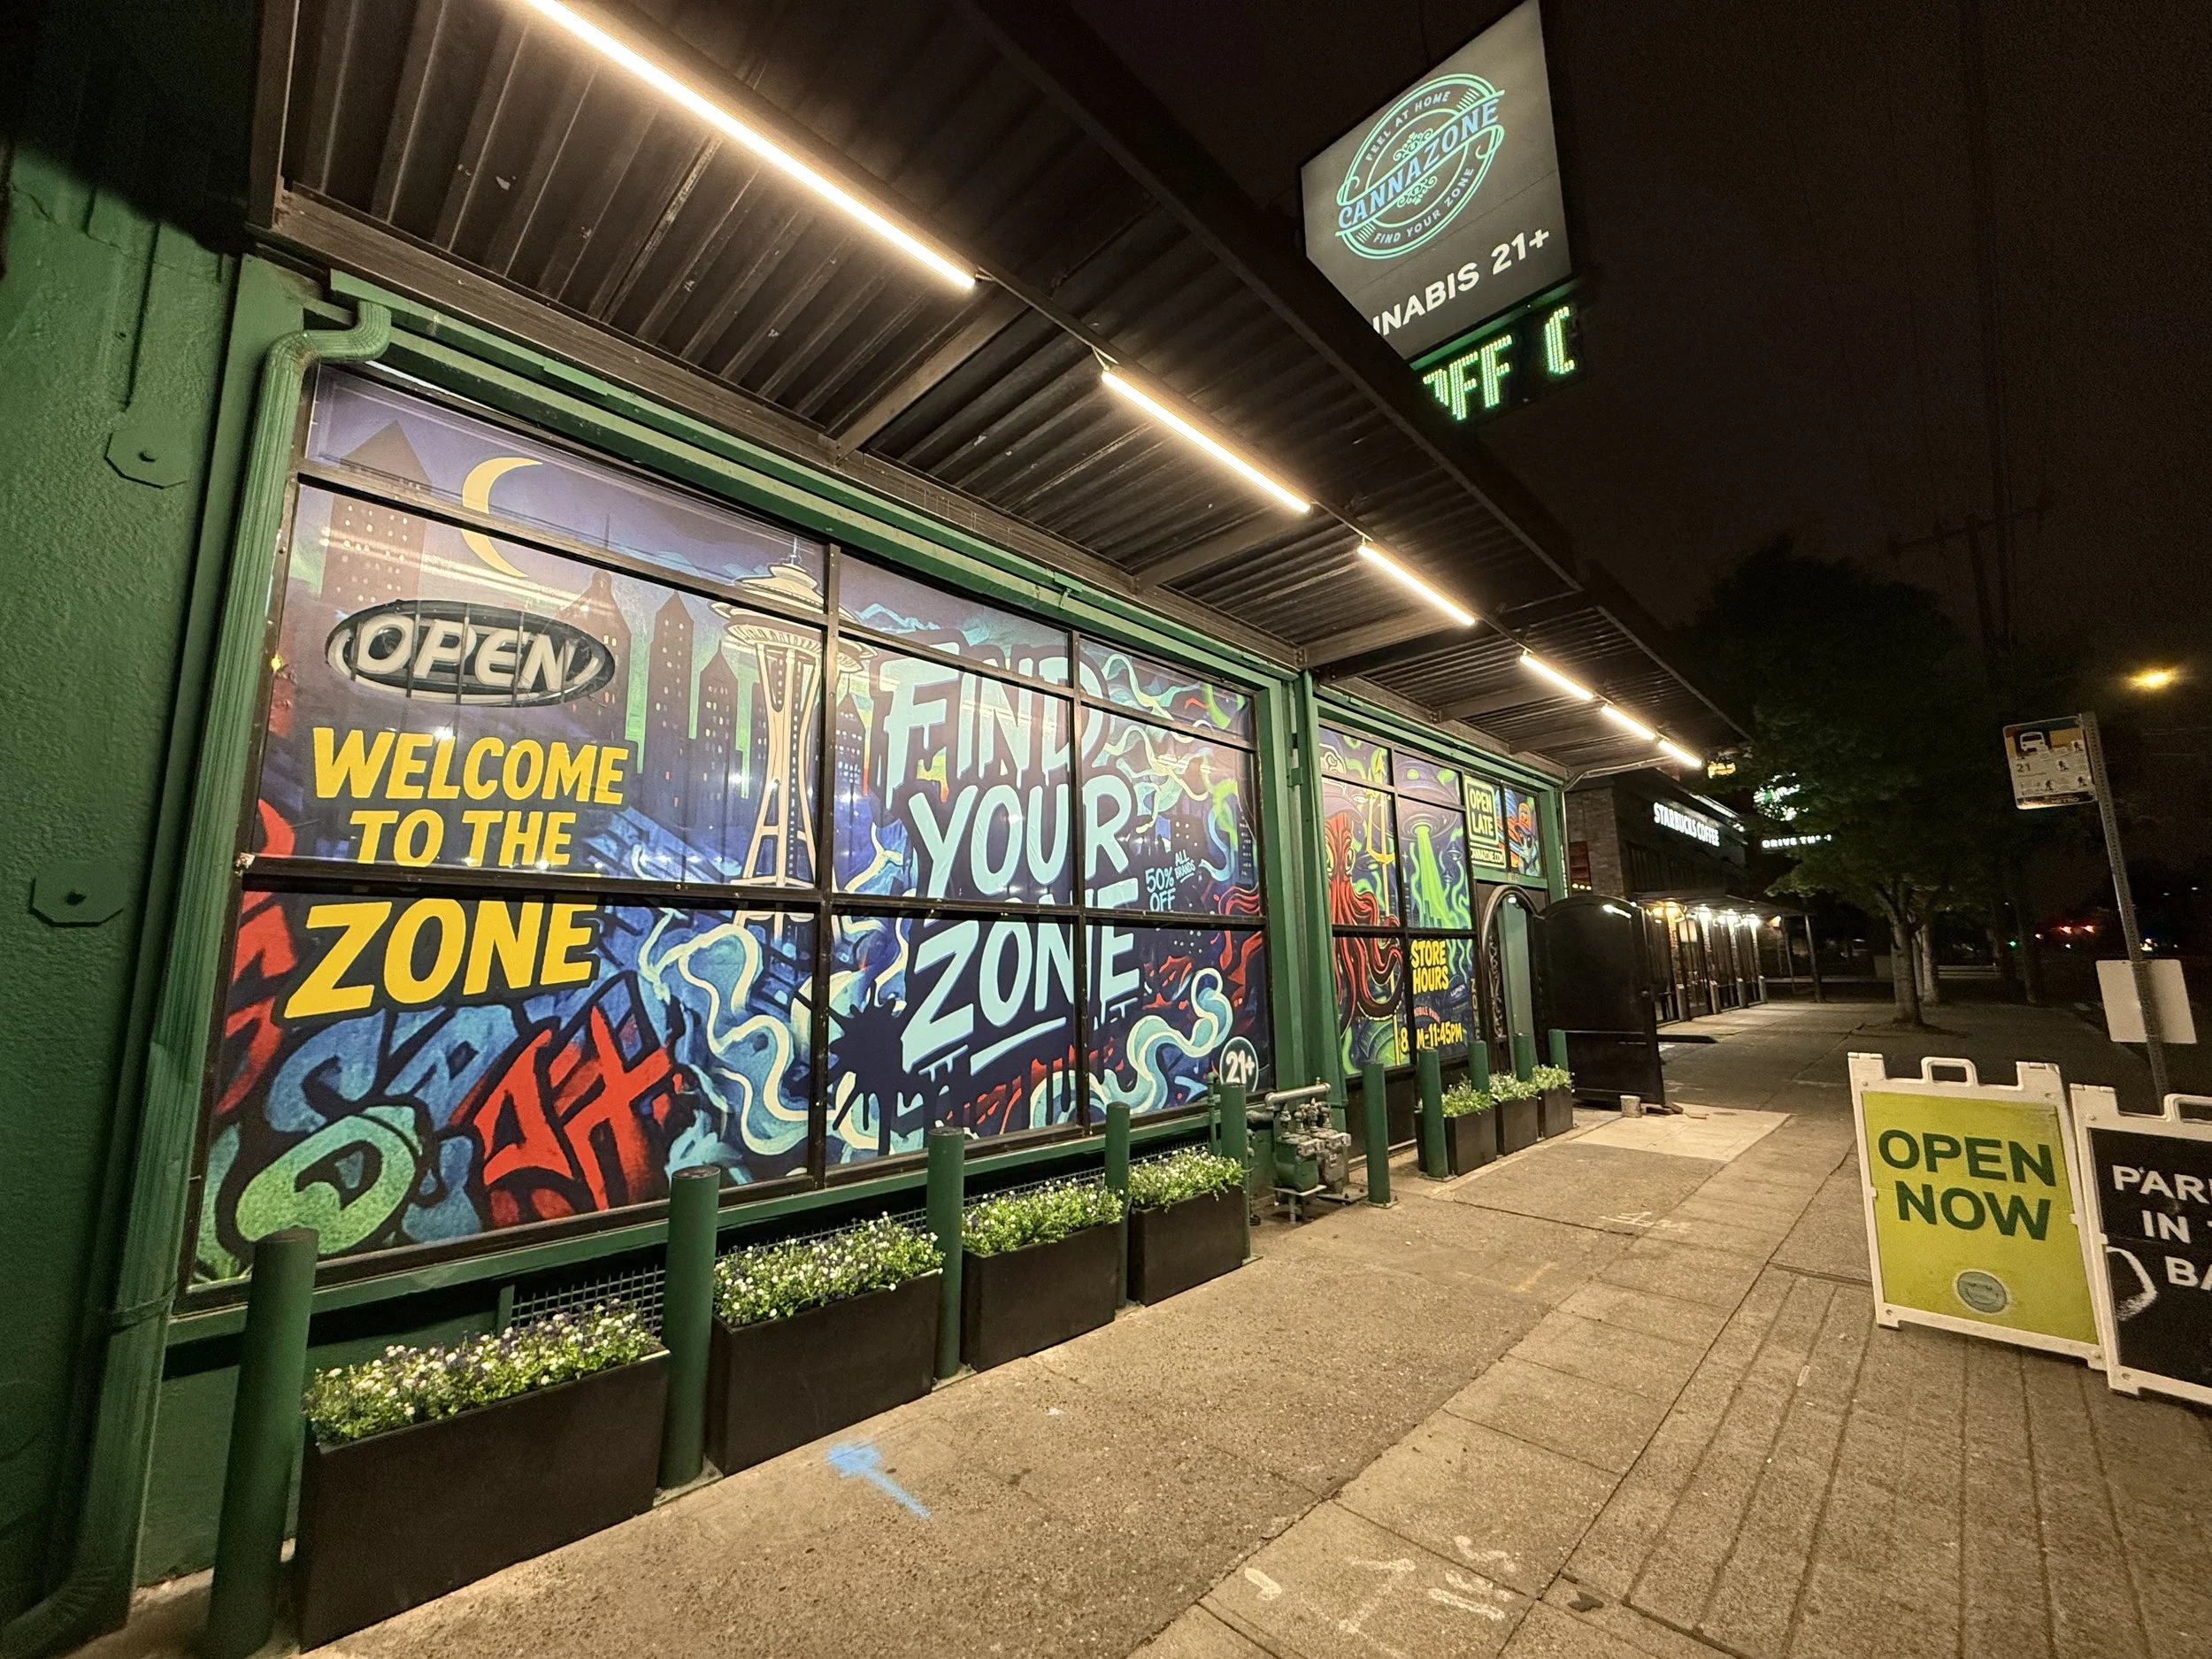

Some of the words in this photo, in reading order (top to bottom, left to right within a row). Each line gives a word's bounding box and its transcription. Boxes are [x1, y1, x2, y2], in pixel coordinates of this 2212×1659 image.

[1365, 130, 1391, 161] FEEL
[1394, 110, 1409, 127] AT
[1415, 90, 1451, 111] HOME
[1338, 98, 1500, 229] CANNAZONE
[1373, 232, 1401, 244] FIND
[1406, 209, 1442, 237] YOUR
[1444, 167, 1474, 208] ZONE
[1490, 228, 1550, 276] 21+
[354, 612, 578, 692] OPEN
[879, 641, 1107, 809] FIND
[313, 727, 629, 804] WELCOME
[2016, 763, 2032, 772] 21
[1469, 787, 1494, 814] OPEN
[349, 809, 443, 868] TO
[462, 810, 577, 867] THE
[908, 775, 1133, 908] YOUR
[1471, 811, 1494, 836] LATE
[1653, 802, 1697, 838] STARBUCKS
[1696, 821, 1720, 847] COFFEE
[1762, 836, 1798, 849] DRIVE
[1174, 859, 1196, 879] BRANDS
[1175, 849, 1190, 866] ALL
[1145, 866, 1175, 894] 50%
[1149, 887, 1177, 912] OFF
[283, 885, 600, 1019] ZONE
[1410, 939, 1447, 969] STORE
[901, 880, 1140, 1074] ZONE
[1412, 964, 1449, 995] HOURS
[1400, 1021, 1463, 1053] 8M-11:45PM
[1225, 1049, 1256, 1084] 21+
[1878, 1129, 2057, 1187] OPEN
[2112, 1164, 2212, 1205] PAR
[1894, 1180, 2052, 1241] NOW
[2141, 1210, 2192, 1244] IN
